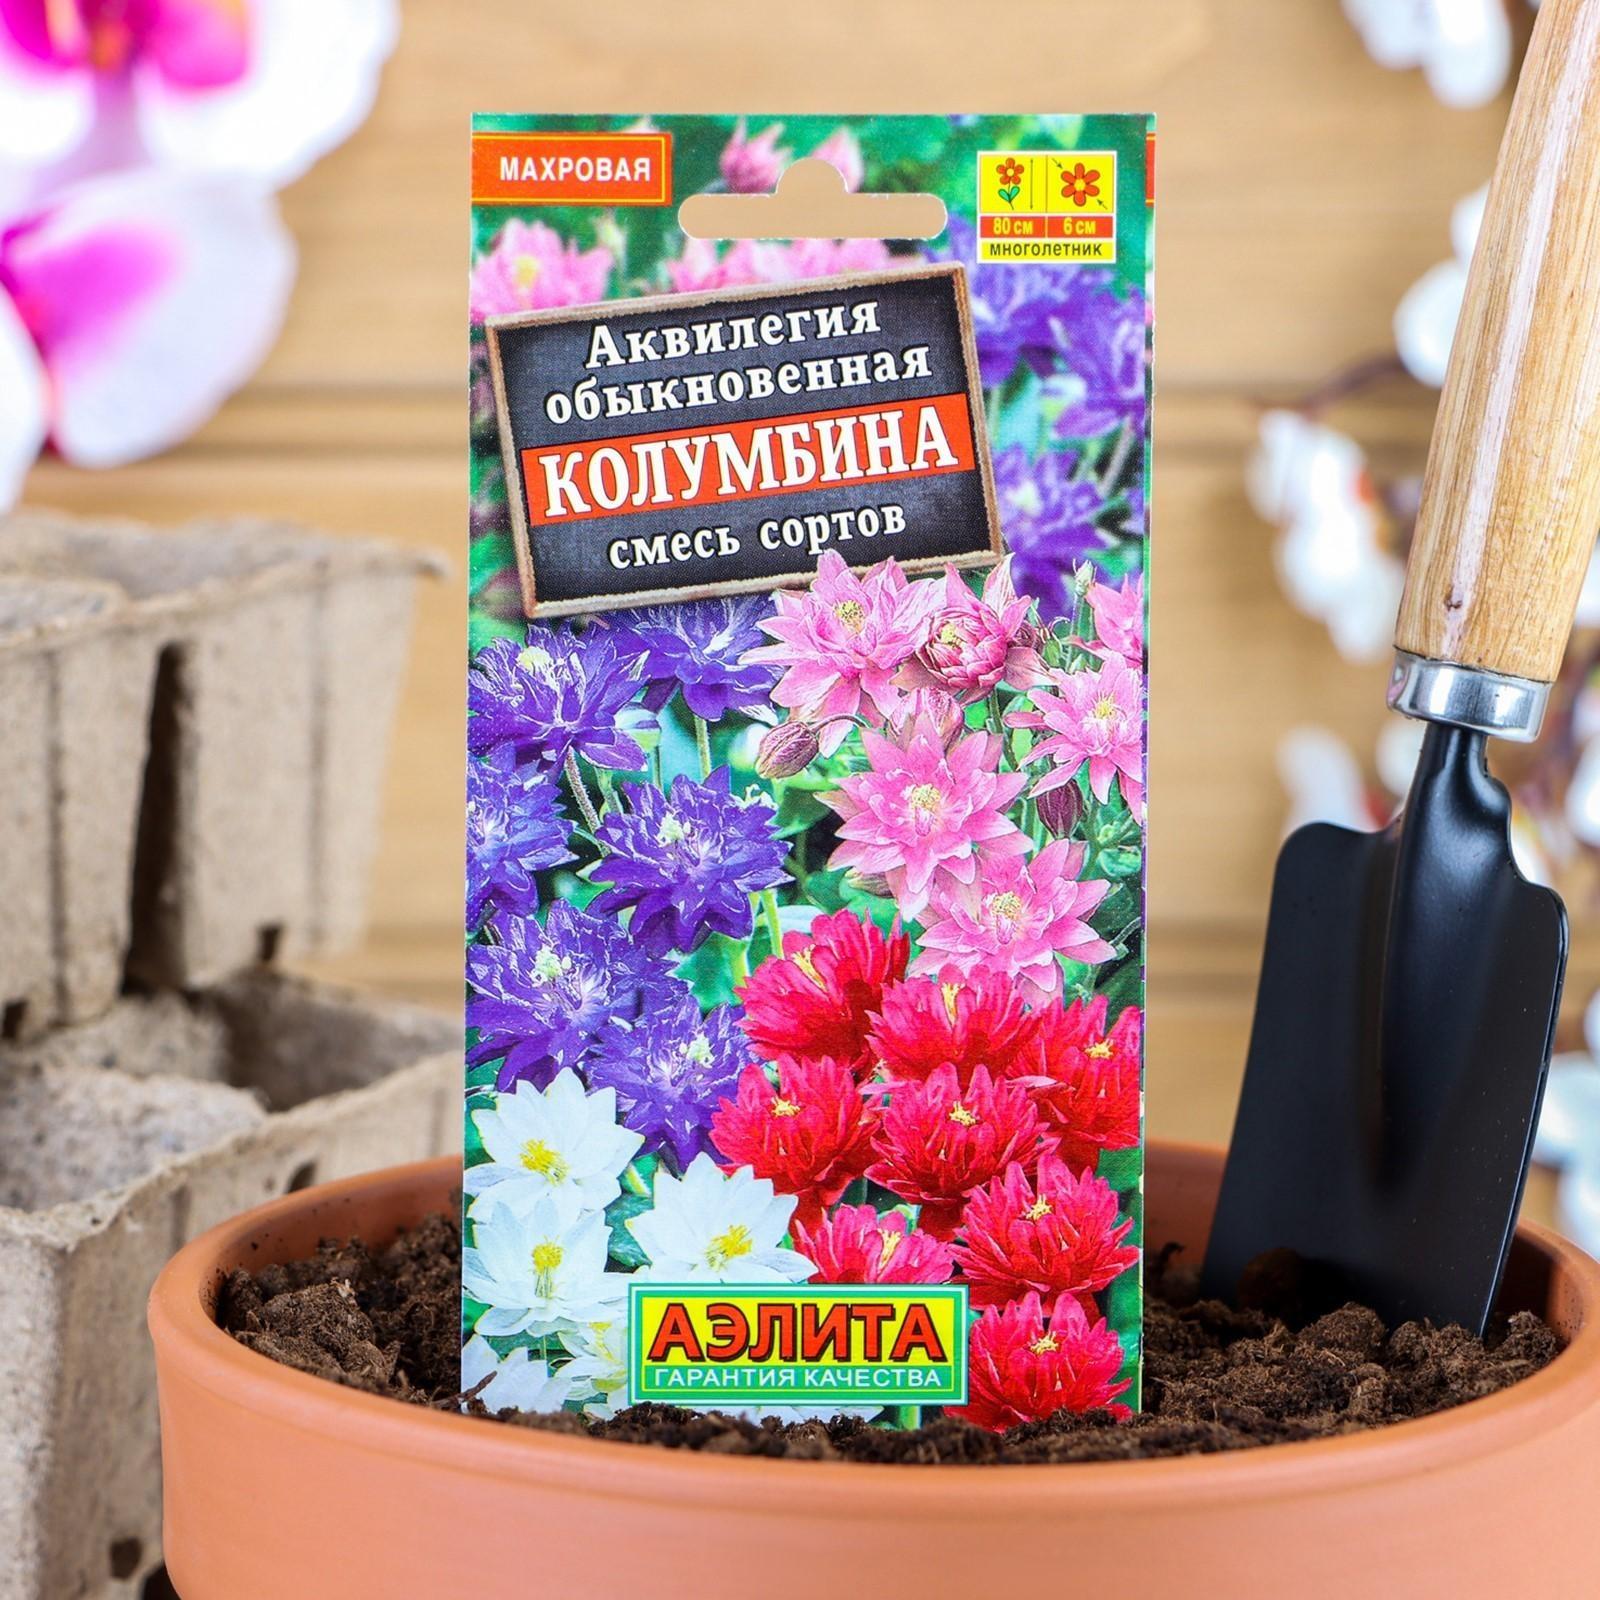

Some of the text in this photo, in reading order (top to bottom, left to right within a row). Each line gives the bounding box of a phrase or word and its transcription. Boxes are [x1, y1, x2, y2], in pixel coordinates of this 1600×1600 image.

[500, 156, 651, 182] МАХРОВАЯ
[993, 217, 1033, 235] 80 см
[1063, 217, 1096, 235] 6 см
[990, 243, 1102, 257] многолетник
[584, 301, 881, 369] Аквилегия
[545, 345, 933, 425] обыкновенная
[539, 406, 960, 517] КОЛУМБИНА
[608, 505, 907, 569] смесь сортов
[646, 1302, 948, 1363] АЭЛИТА
[655, 1368, 942, 1387] ГАРАНТИЯ КАЧЕСТВА
